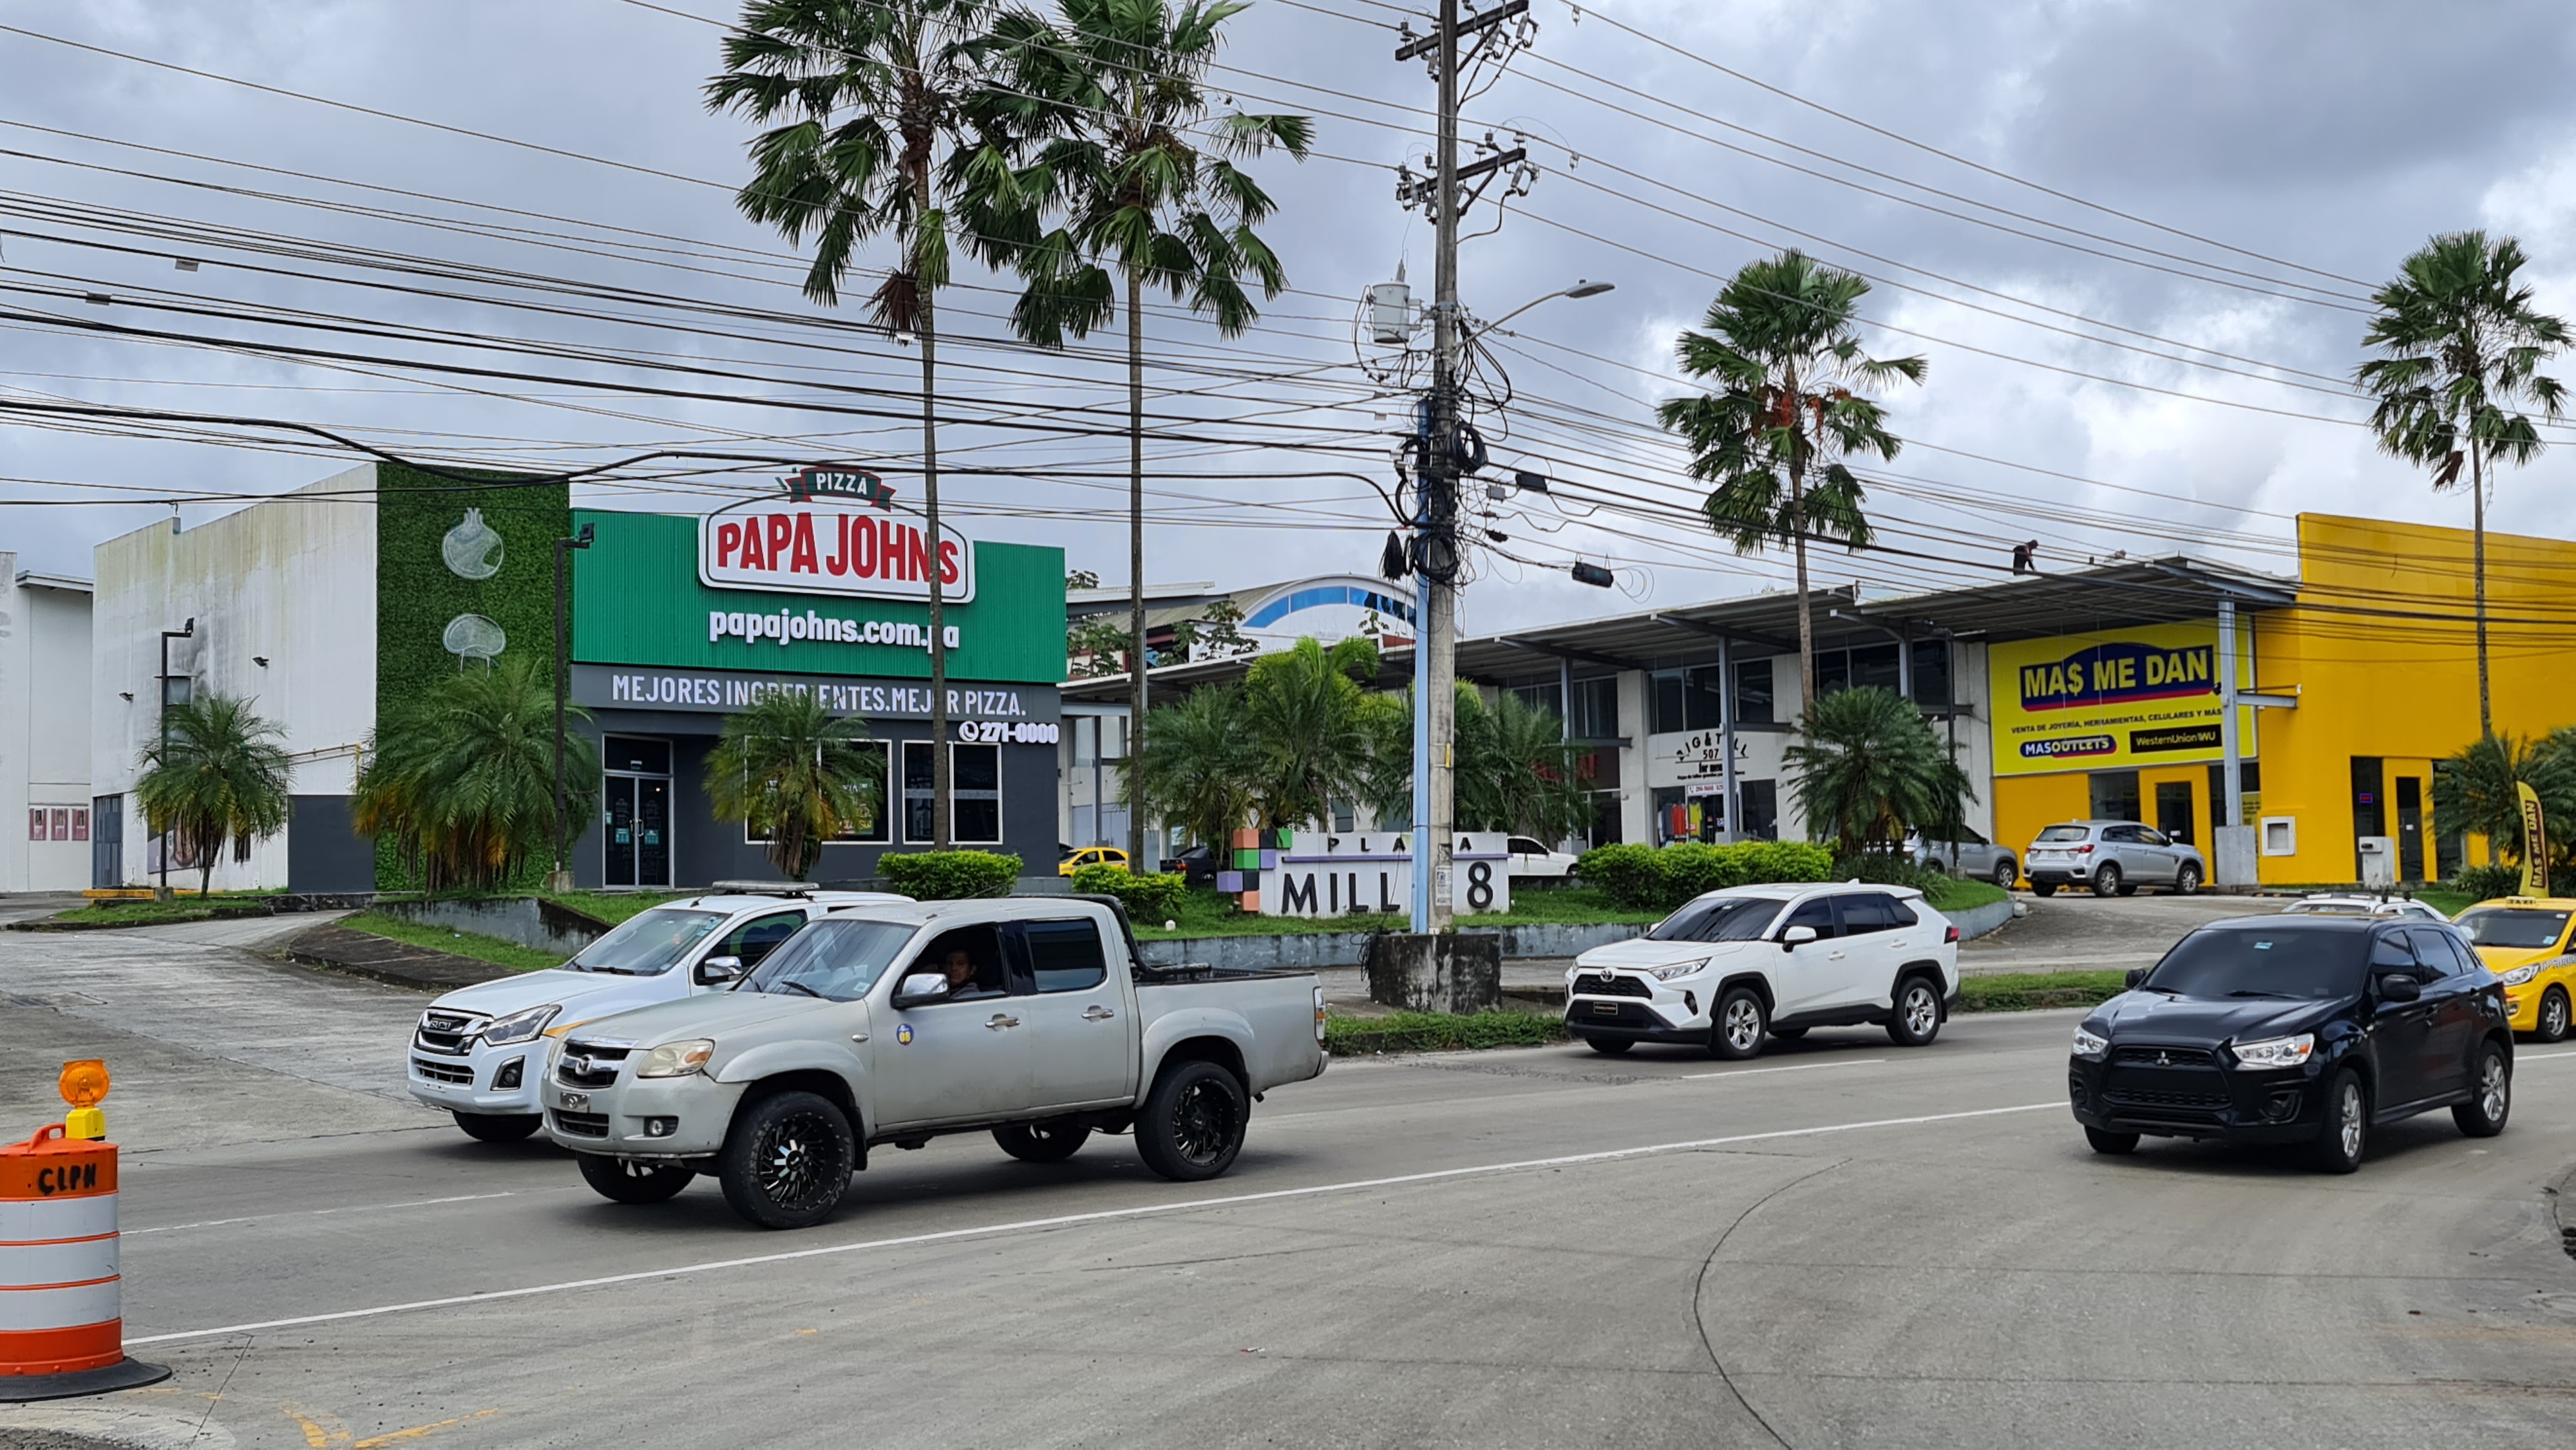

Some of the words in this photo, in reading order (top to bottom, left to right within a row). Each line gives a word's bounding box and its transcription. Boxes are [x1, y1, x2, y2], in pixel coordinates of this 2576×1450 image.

[815, 472, 867, 495] PIZZA
[717, 513, 819, 574] PAPA
[826, 514, 959, 585] JOHNS
[2093, 657, 2136, 692] ME
[2145, 650, 2208, 686] DAN
[612, 675, 721, 704] MEJORES
[979, 722, 1059, 744] 271-0000
[2011, 725, 2036, 734] VENTA
[2037, 724, 2047, 732] DE
[2148, 710, 2194, 721] CELULARES
[1703, 748, 1719, 759] 507
[1716, 733, 1747, 757] TLL
[2526, 802, 2538, 831] DAN
[1327, 837, 1473, 852] PLAA
[1281, 872, 1401, 913] MILL
[1466, 861, 1494, 910] 8
